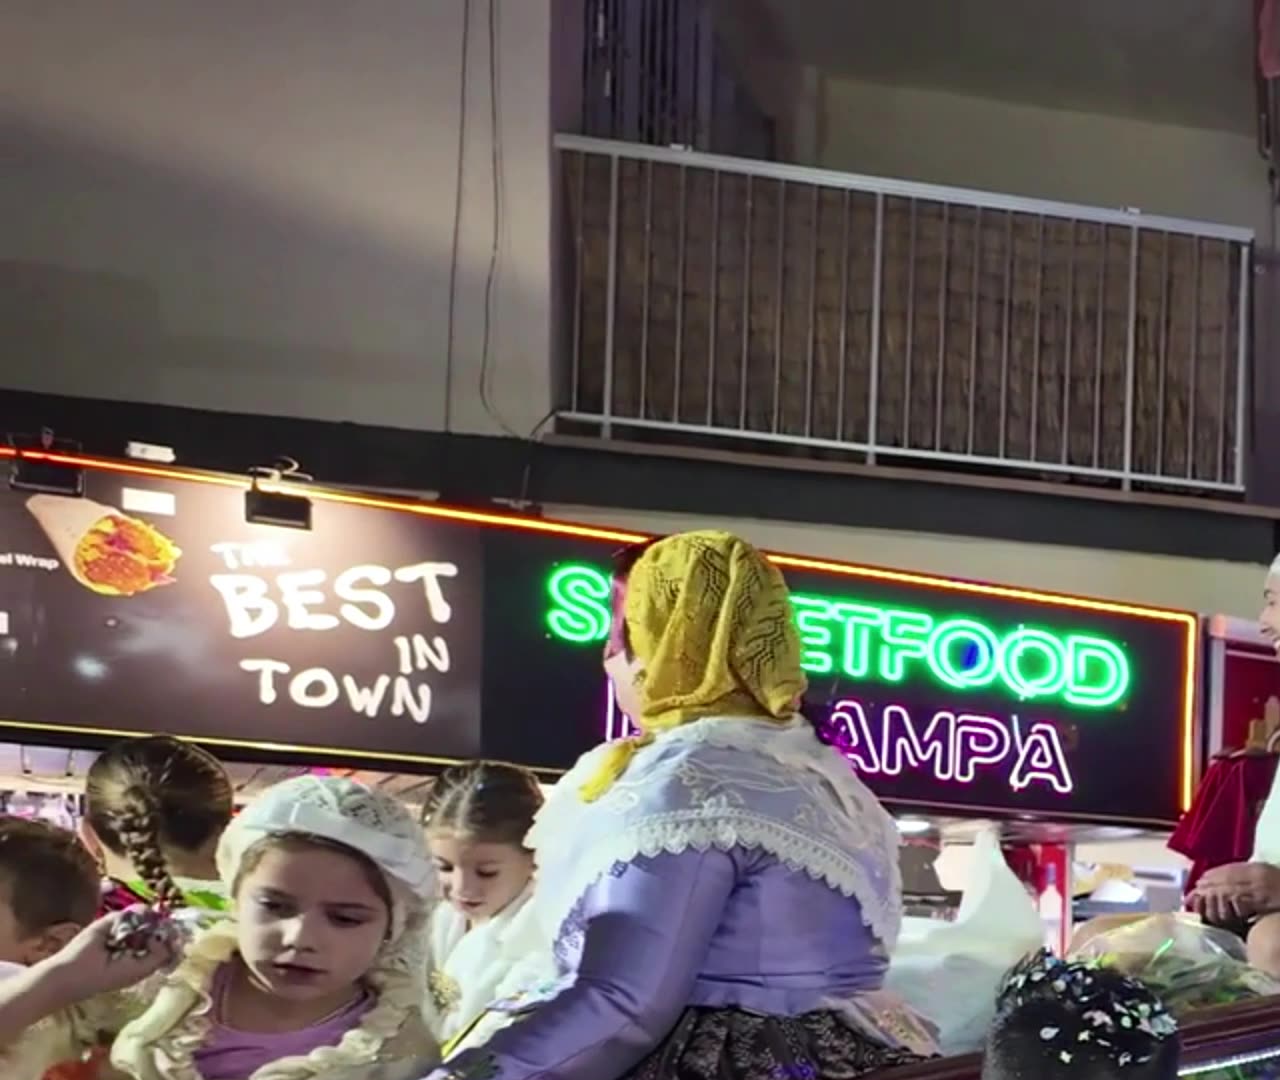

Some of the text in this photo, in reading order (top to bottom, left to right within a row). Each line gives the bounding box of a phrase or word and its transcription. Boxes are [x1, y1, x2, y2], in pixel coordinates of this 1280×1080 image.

[15, 553, 60, 571] Wrap
[210, 542, 292, 570] THE
[210, 561, 458, 638] BEST
[394, 633, 450, 675] IN
[239, 658, 432, 724] TOWN
[828, 699, 1073, 794] AMPA
